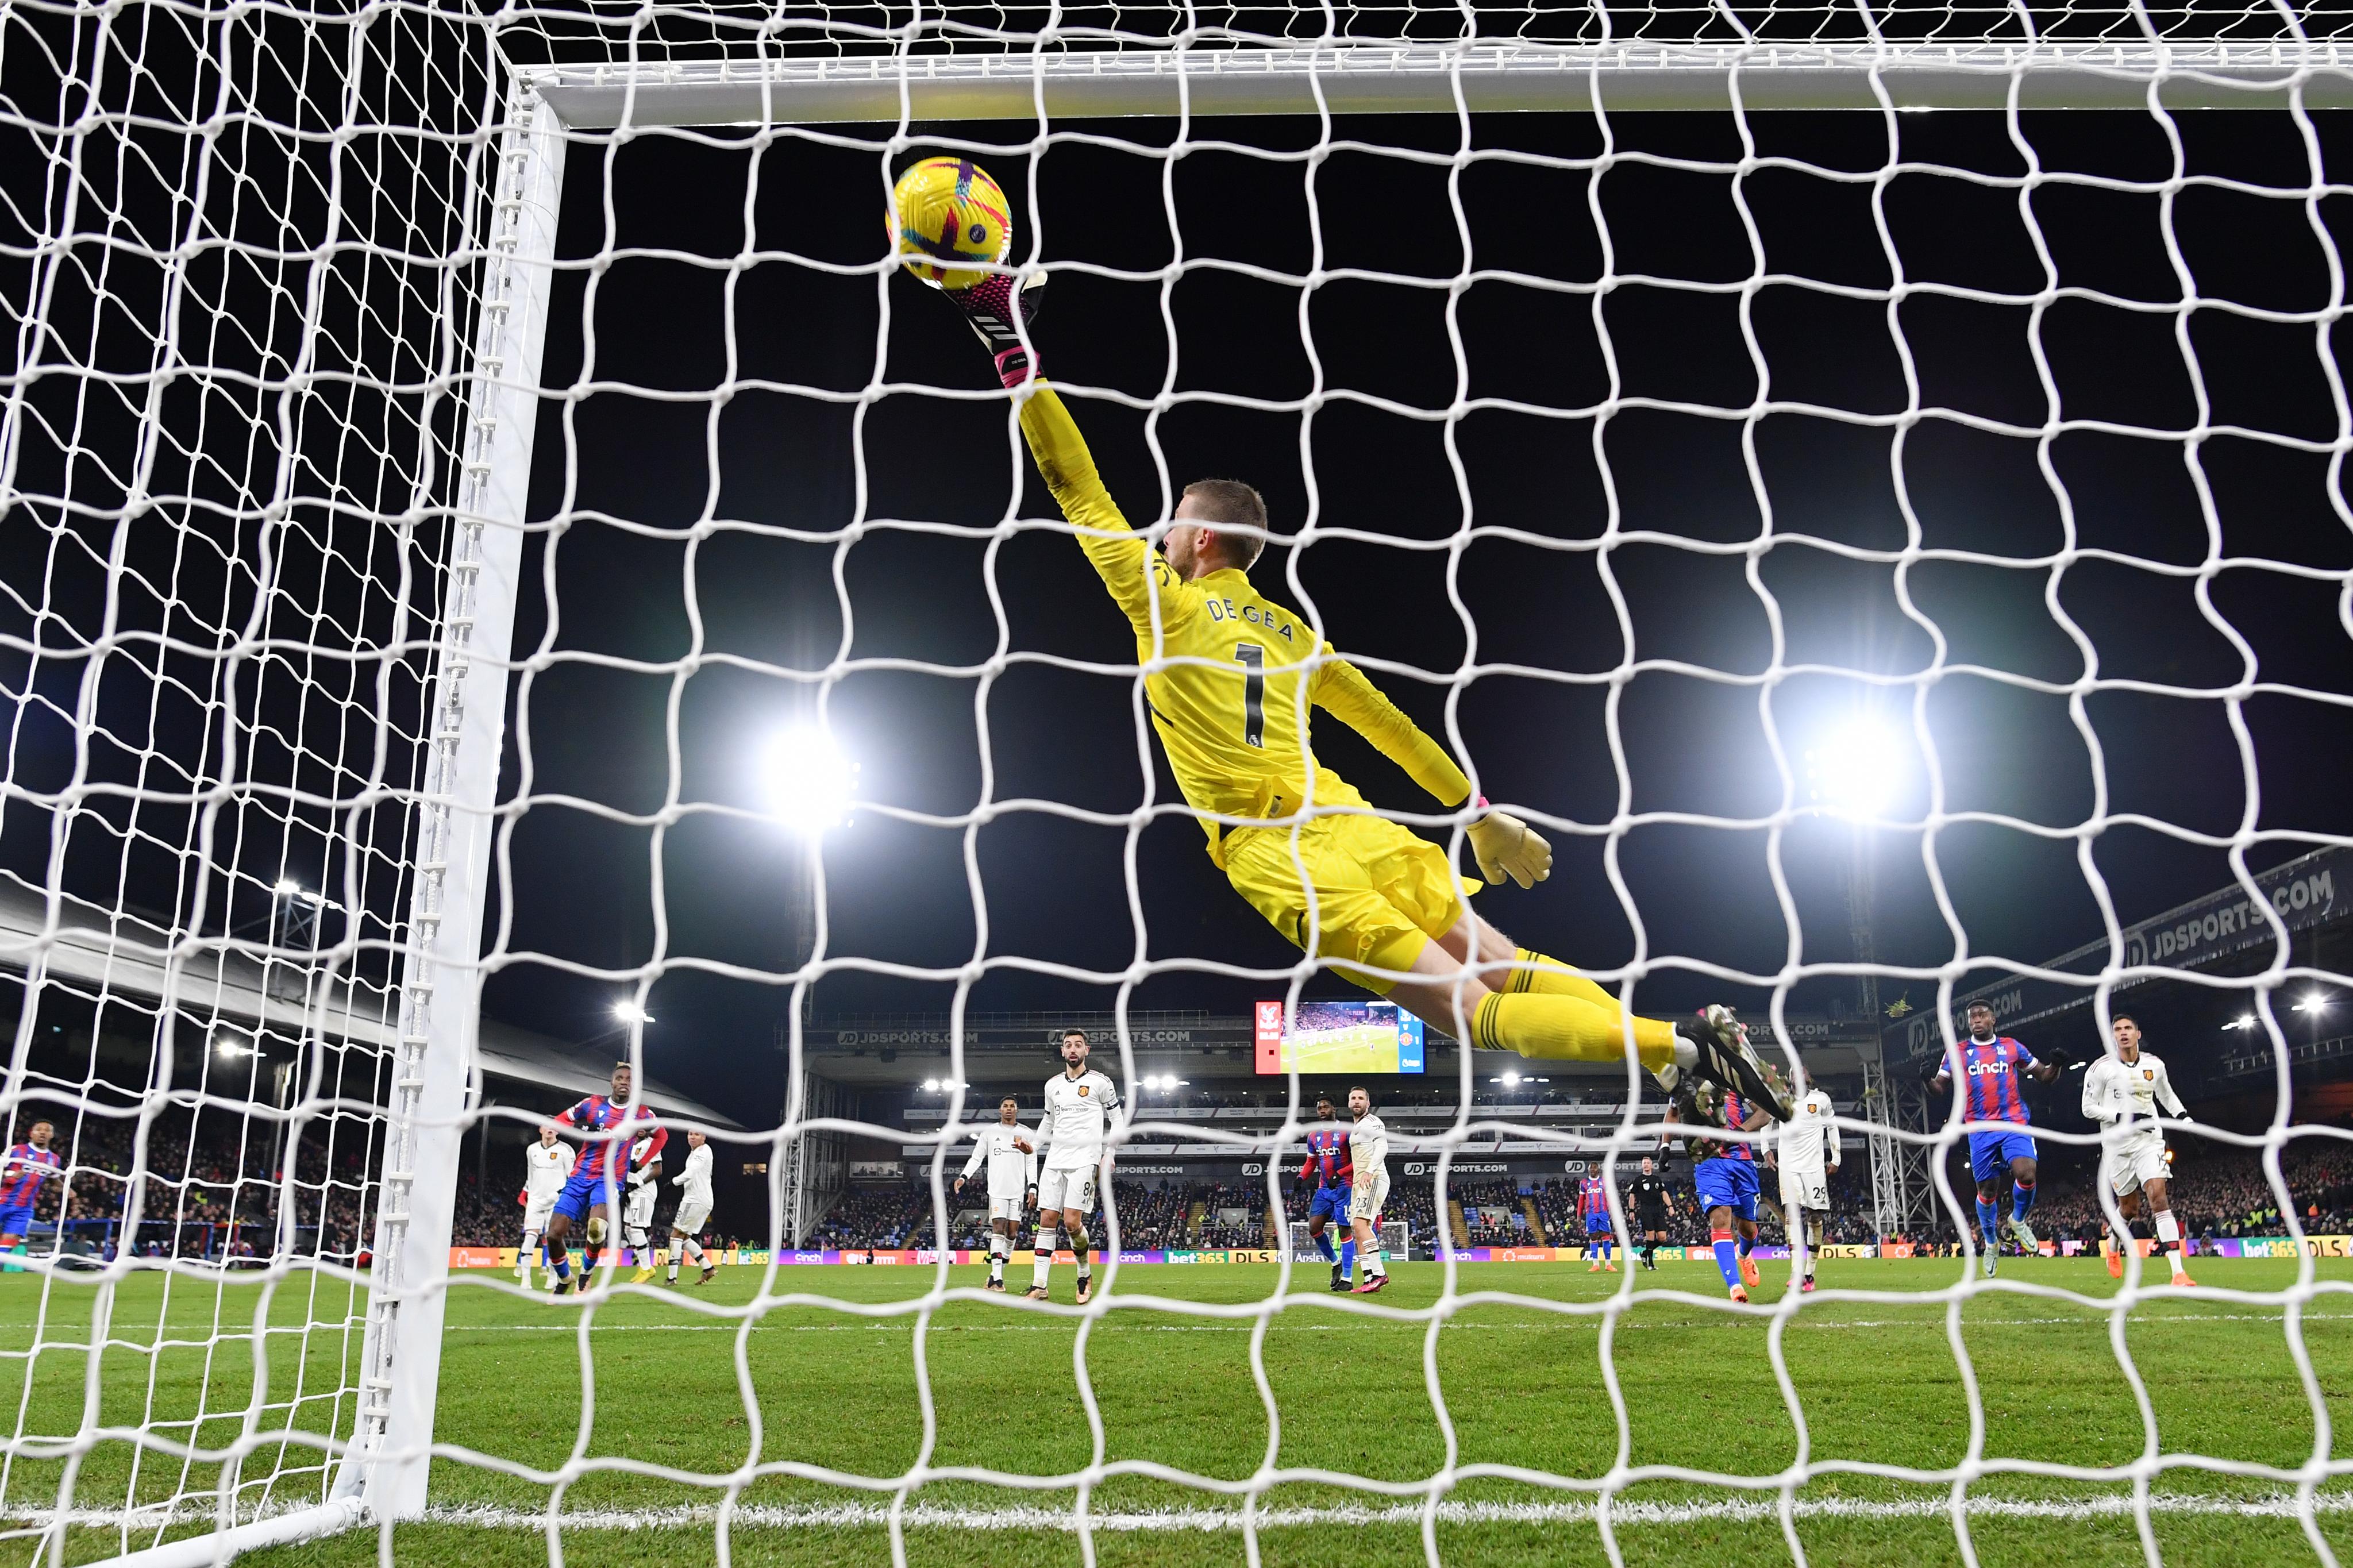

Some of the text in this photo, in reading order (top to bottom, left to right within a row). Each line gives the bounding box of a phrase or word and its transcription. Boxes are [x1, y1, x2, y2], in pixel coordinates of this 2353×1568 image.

[1206, 599, 1292, 642] DE GEA
[1235, 642, 1265, 748] 1
[2152, 869, 2333, 961] JDSPORTSCOM
[860, 1033, 979, 1044] JDSPORTS.CM
[1967, 1060, 2009, 1076] cinch
[1243, 1164, 1261, 1175] JD
[1405, 1164, 1508, 1174] JD JDPORTS.COM
[1566, 1161, 1584, 1172] JD
[1083, 1181, 1091, 1196] 8
[1812, 1186, 1826, 1200] 29
[1355, 1197, 1368, 1208] 23
[1772, 1247, 1790, 1258] cinc
[1823, 1247, 1857, 1258] DLS
[2243, 1240, 2297, 1258] bet365
[2308, 1239, 2343, 1257] DLS
[738, 1251, 769, 1265] bet365
[795, 1251, 822, 1263] cinch
[1119, 1252, 1145, 1262] cinch
[1168, 1252, 1225, 1264] bet365
[1236, 1252, 1269, 1263] DLS
[1630, 1250, 1682, 1261] be365
